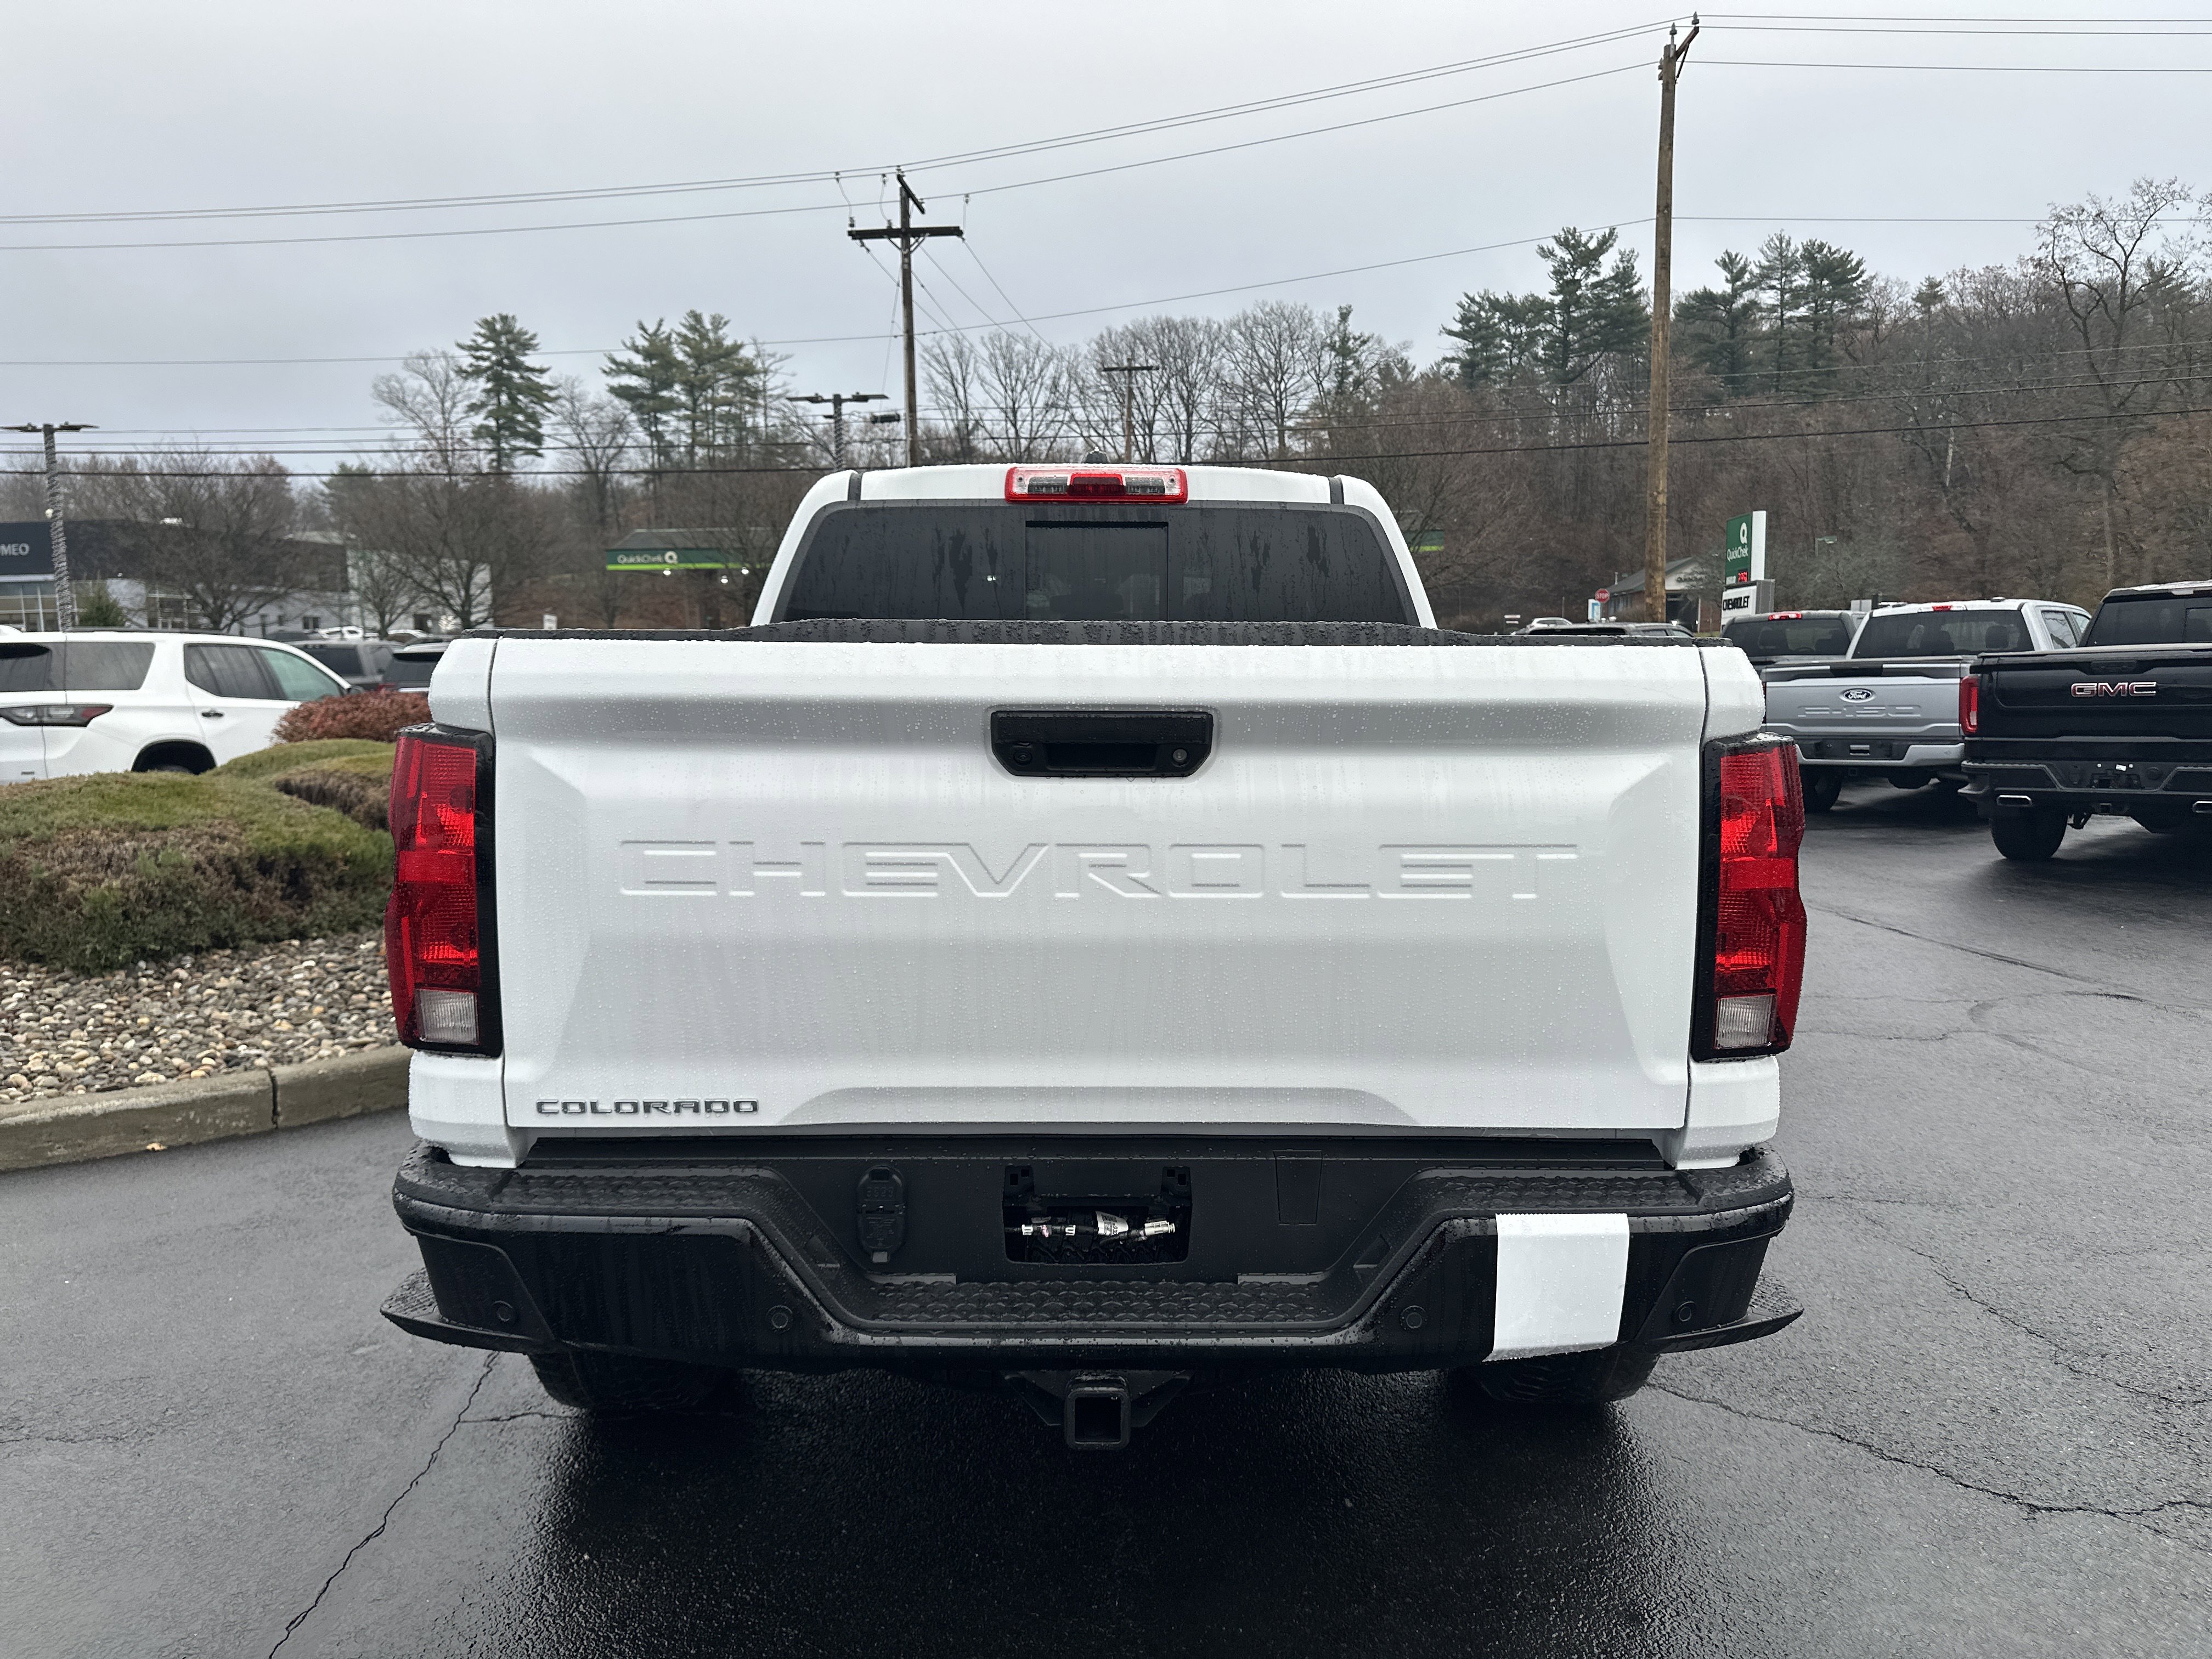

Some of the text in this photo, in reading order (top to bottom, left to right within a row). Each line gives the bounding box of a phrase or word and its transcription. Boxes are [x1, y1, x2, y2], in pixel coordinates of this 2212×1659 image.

[0, 543, 30, 556] MEO
[1723, 595, 1750, 611] CHEVROLET
[1846, 690, 1868, 700] Ford
[2071, 681, 2157, 697] GMC
[1797, 704, 1921, 718] F-150
[619, 840, 1579, 898] CHEVROLET
[535, 1098, 759, 1114] COLORADO
